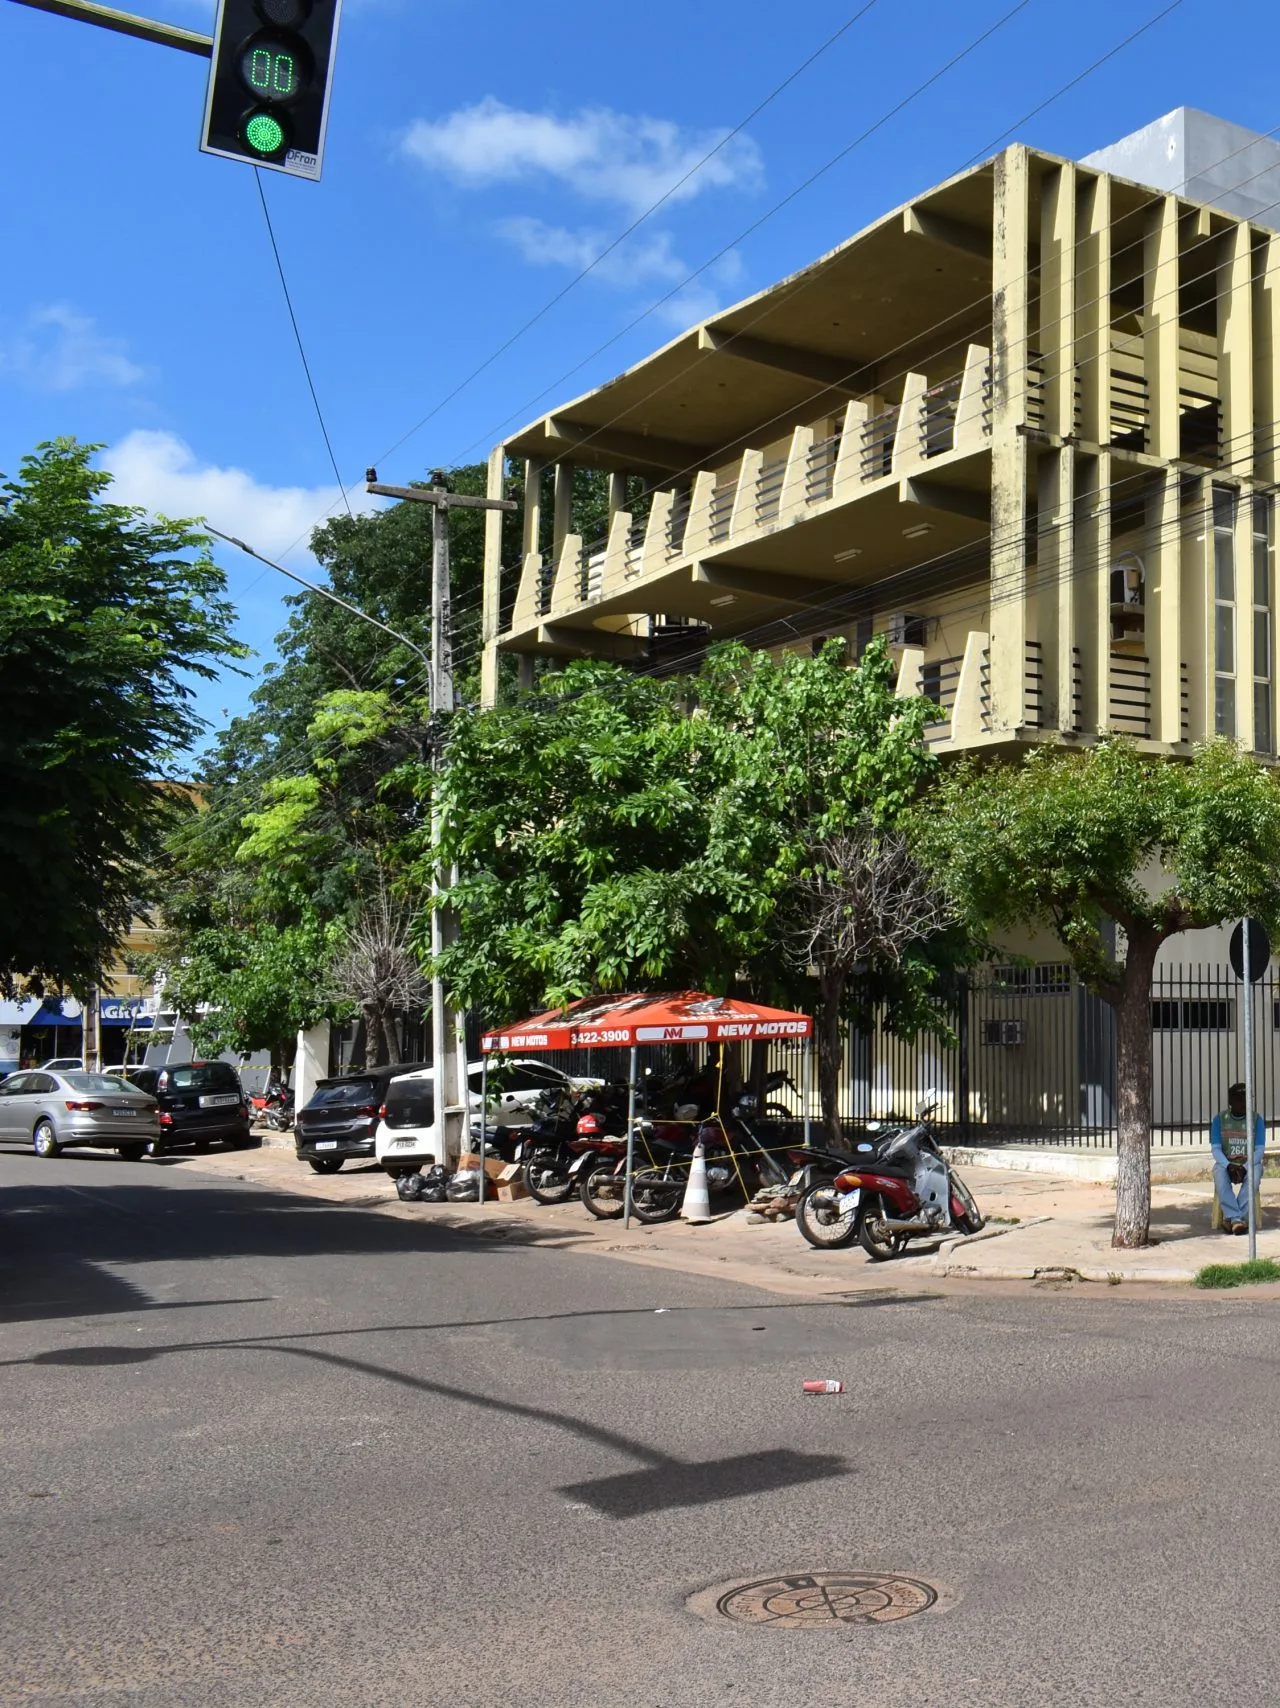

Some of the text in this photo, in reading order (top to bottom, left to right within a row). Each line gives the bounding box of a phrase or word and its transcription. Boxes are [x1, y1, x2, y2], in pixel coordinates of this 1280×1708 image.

[251, 49, 293, 92] 00
[717, 1024, 754, 1037] NEW
[755, 1021, 808, 1035] MOTOS
[511, 1035, 526, 1047] NEW
[571, 1029, 630, 1044] 3422-3900
[1230, 1145, 1245, 1155] 264
